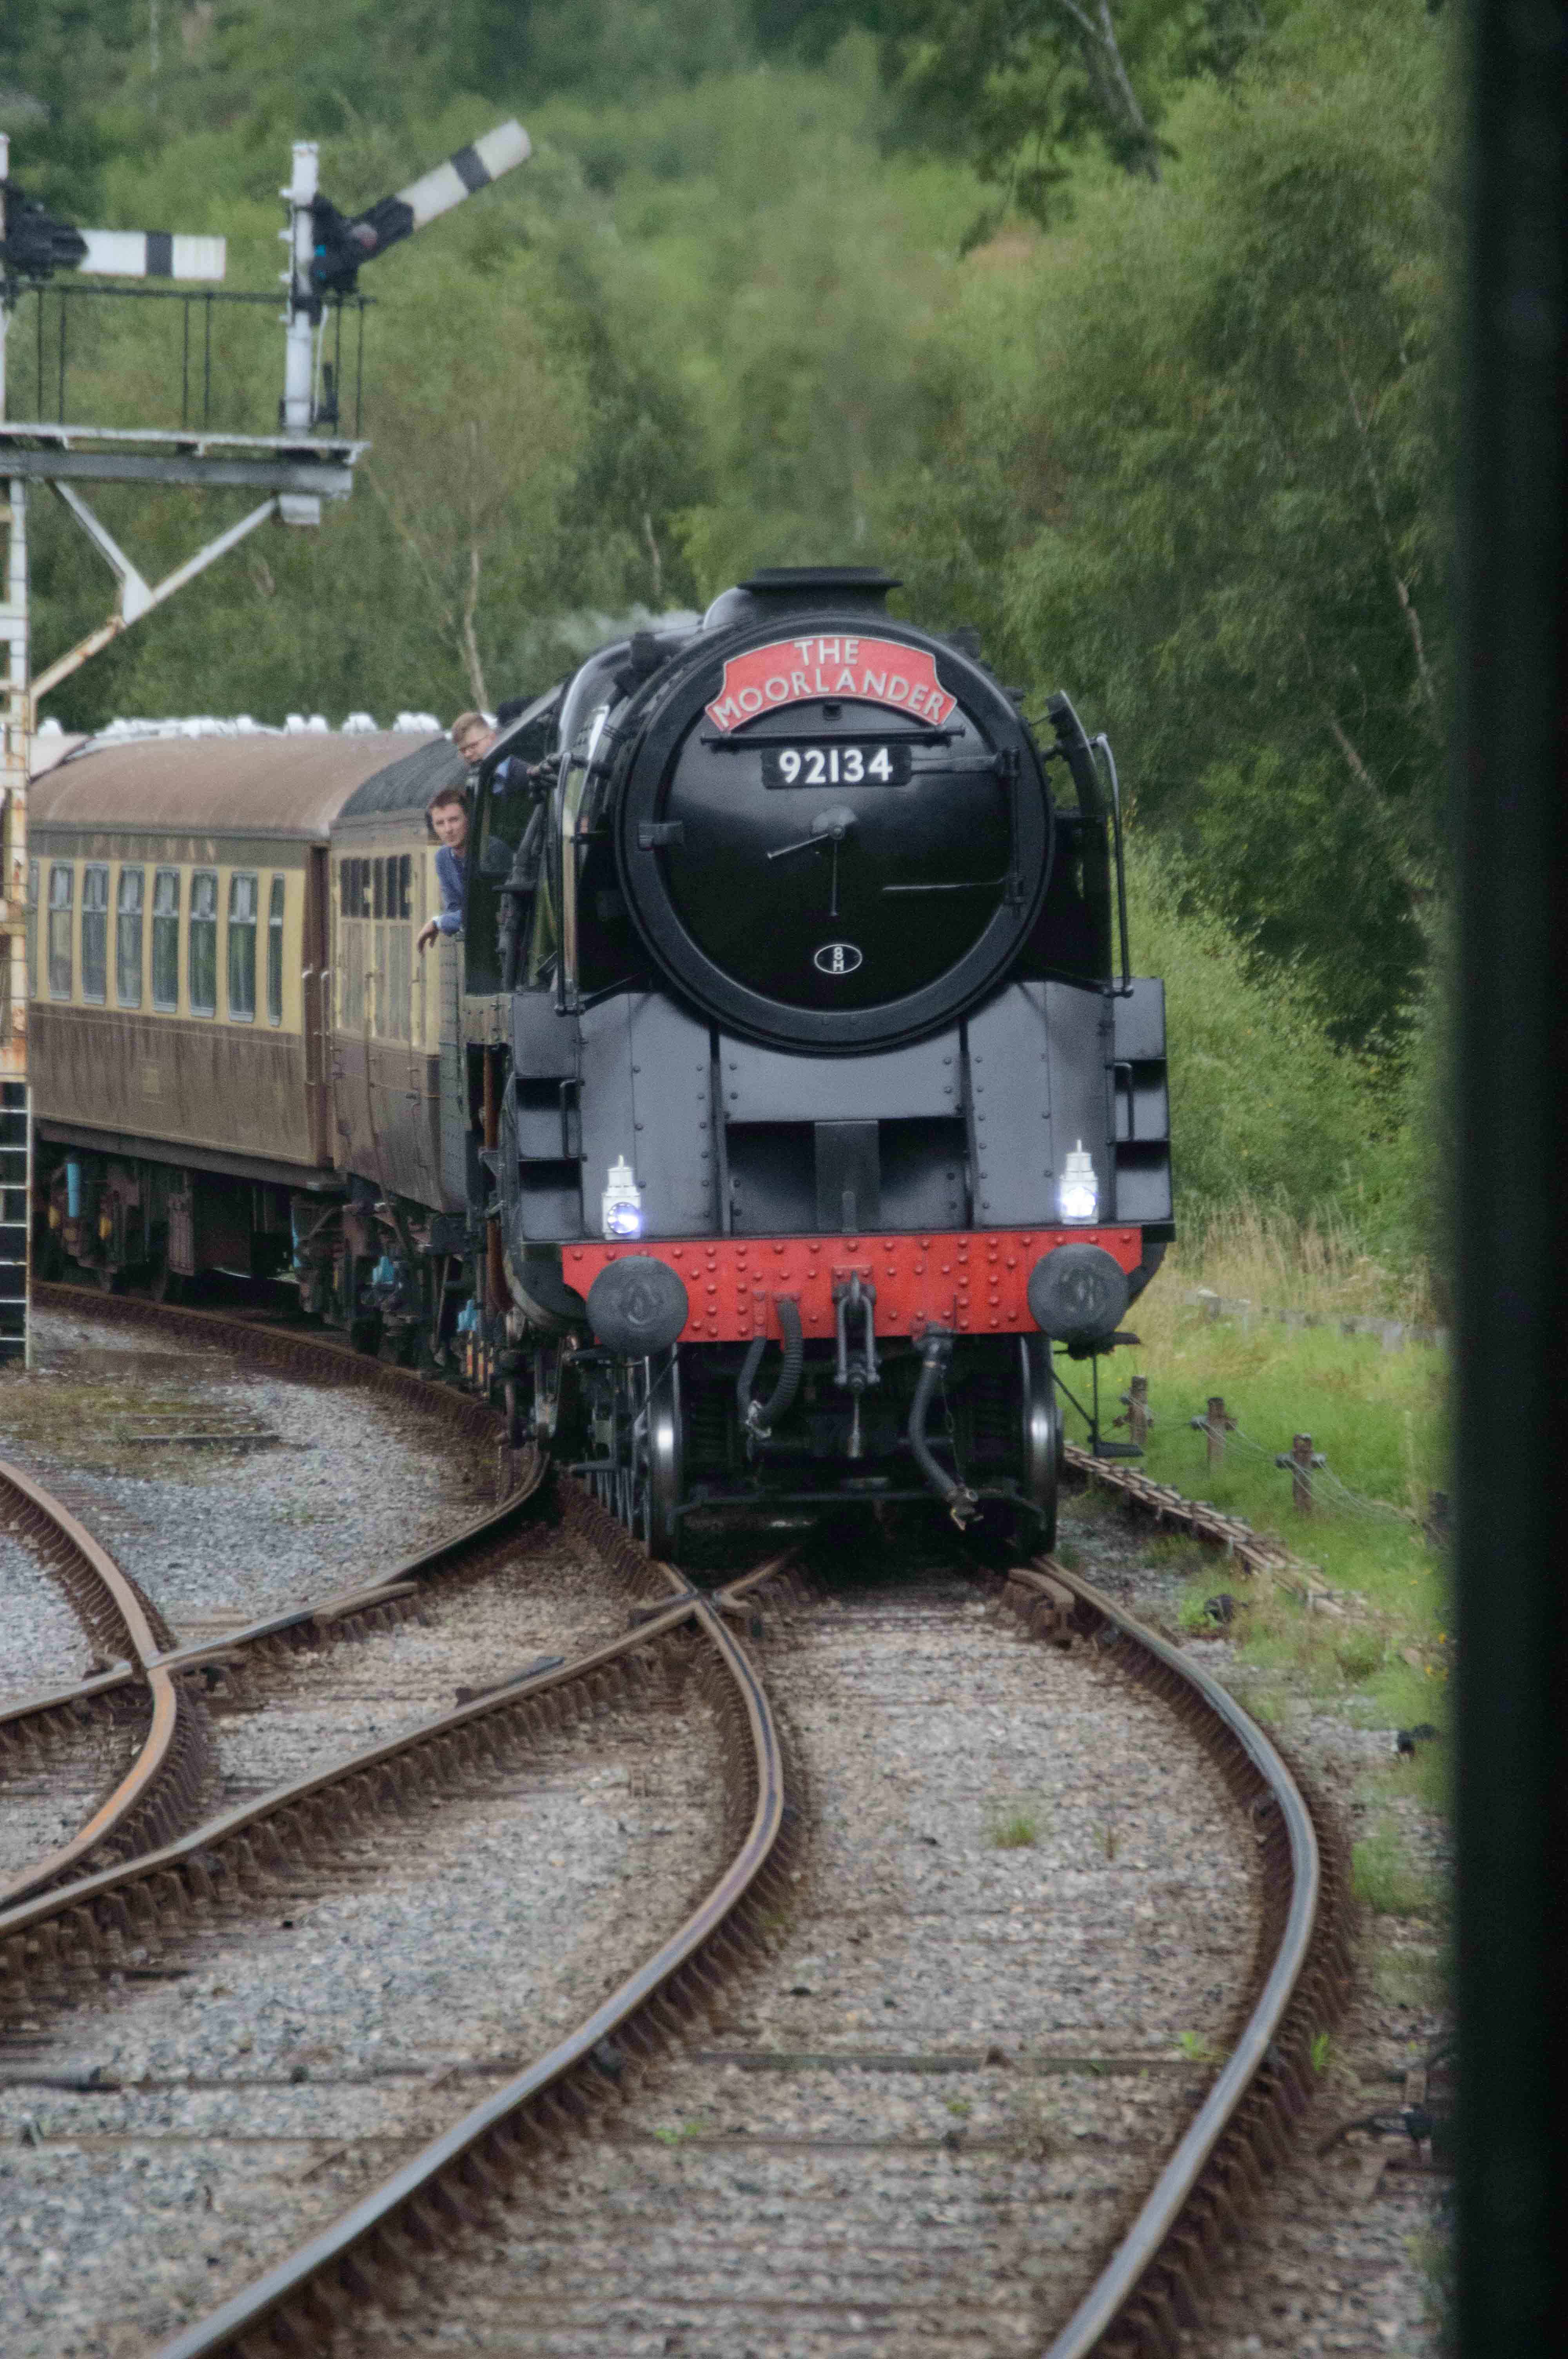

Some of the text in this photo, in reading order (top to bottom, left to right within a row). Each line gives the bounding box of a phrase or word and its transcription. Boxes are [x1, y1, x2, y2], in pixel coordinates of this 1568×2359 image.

[795, 639, 860, 665] THE
[714, 668, 944, 727] MOORLANDER
[779, 748, 893, 783] 92134
